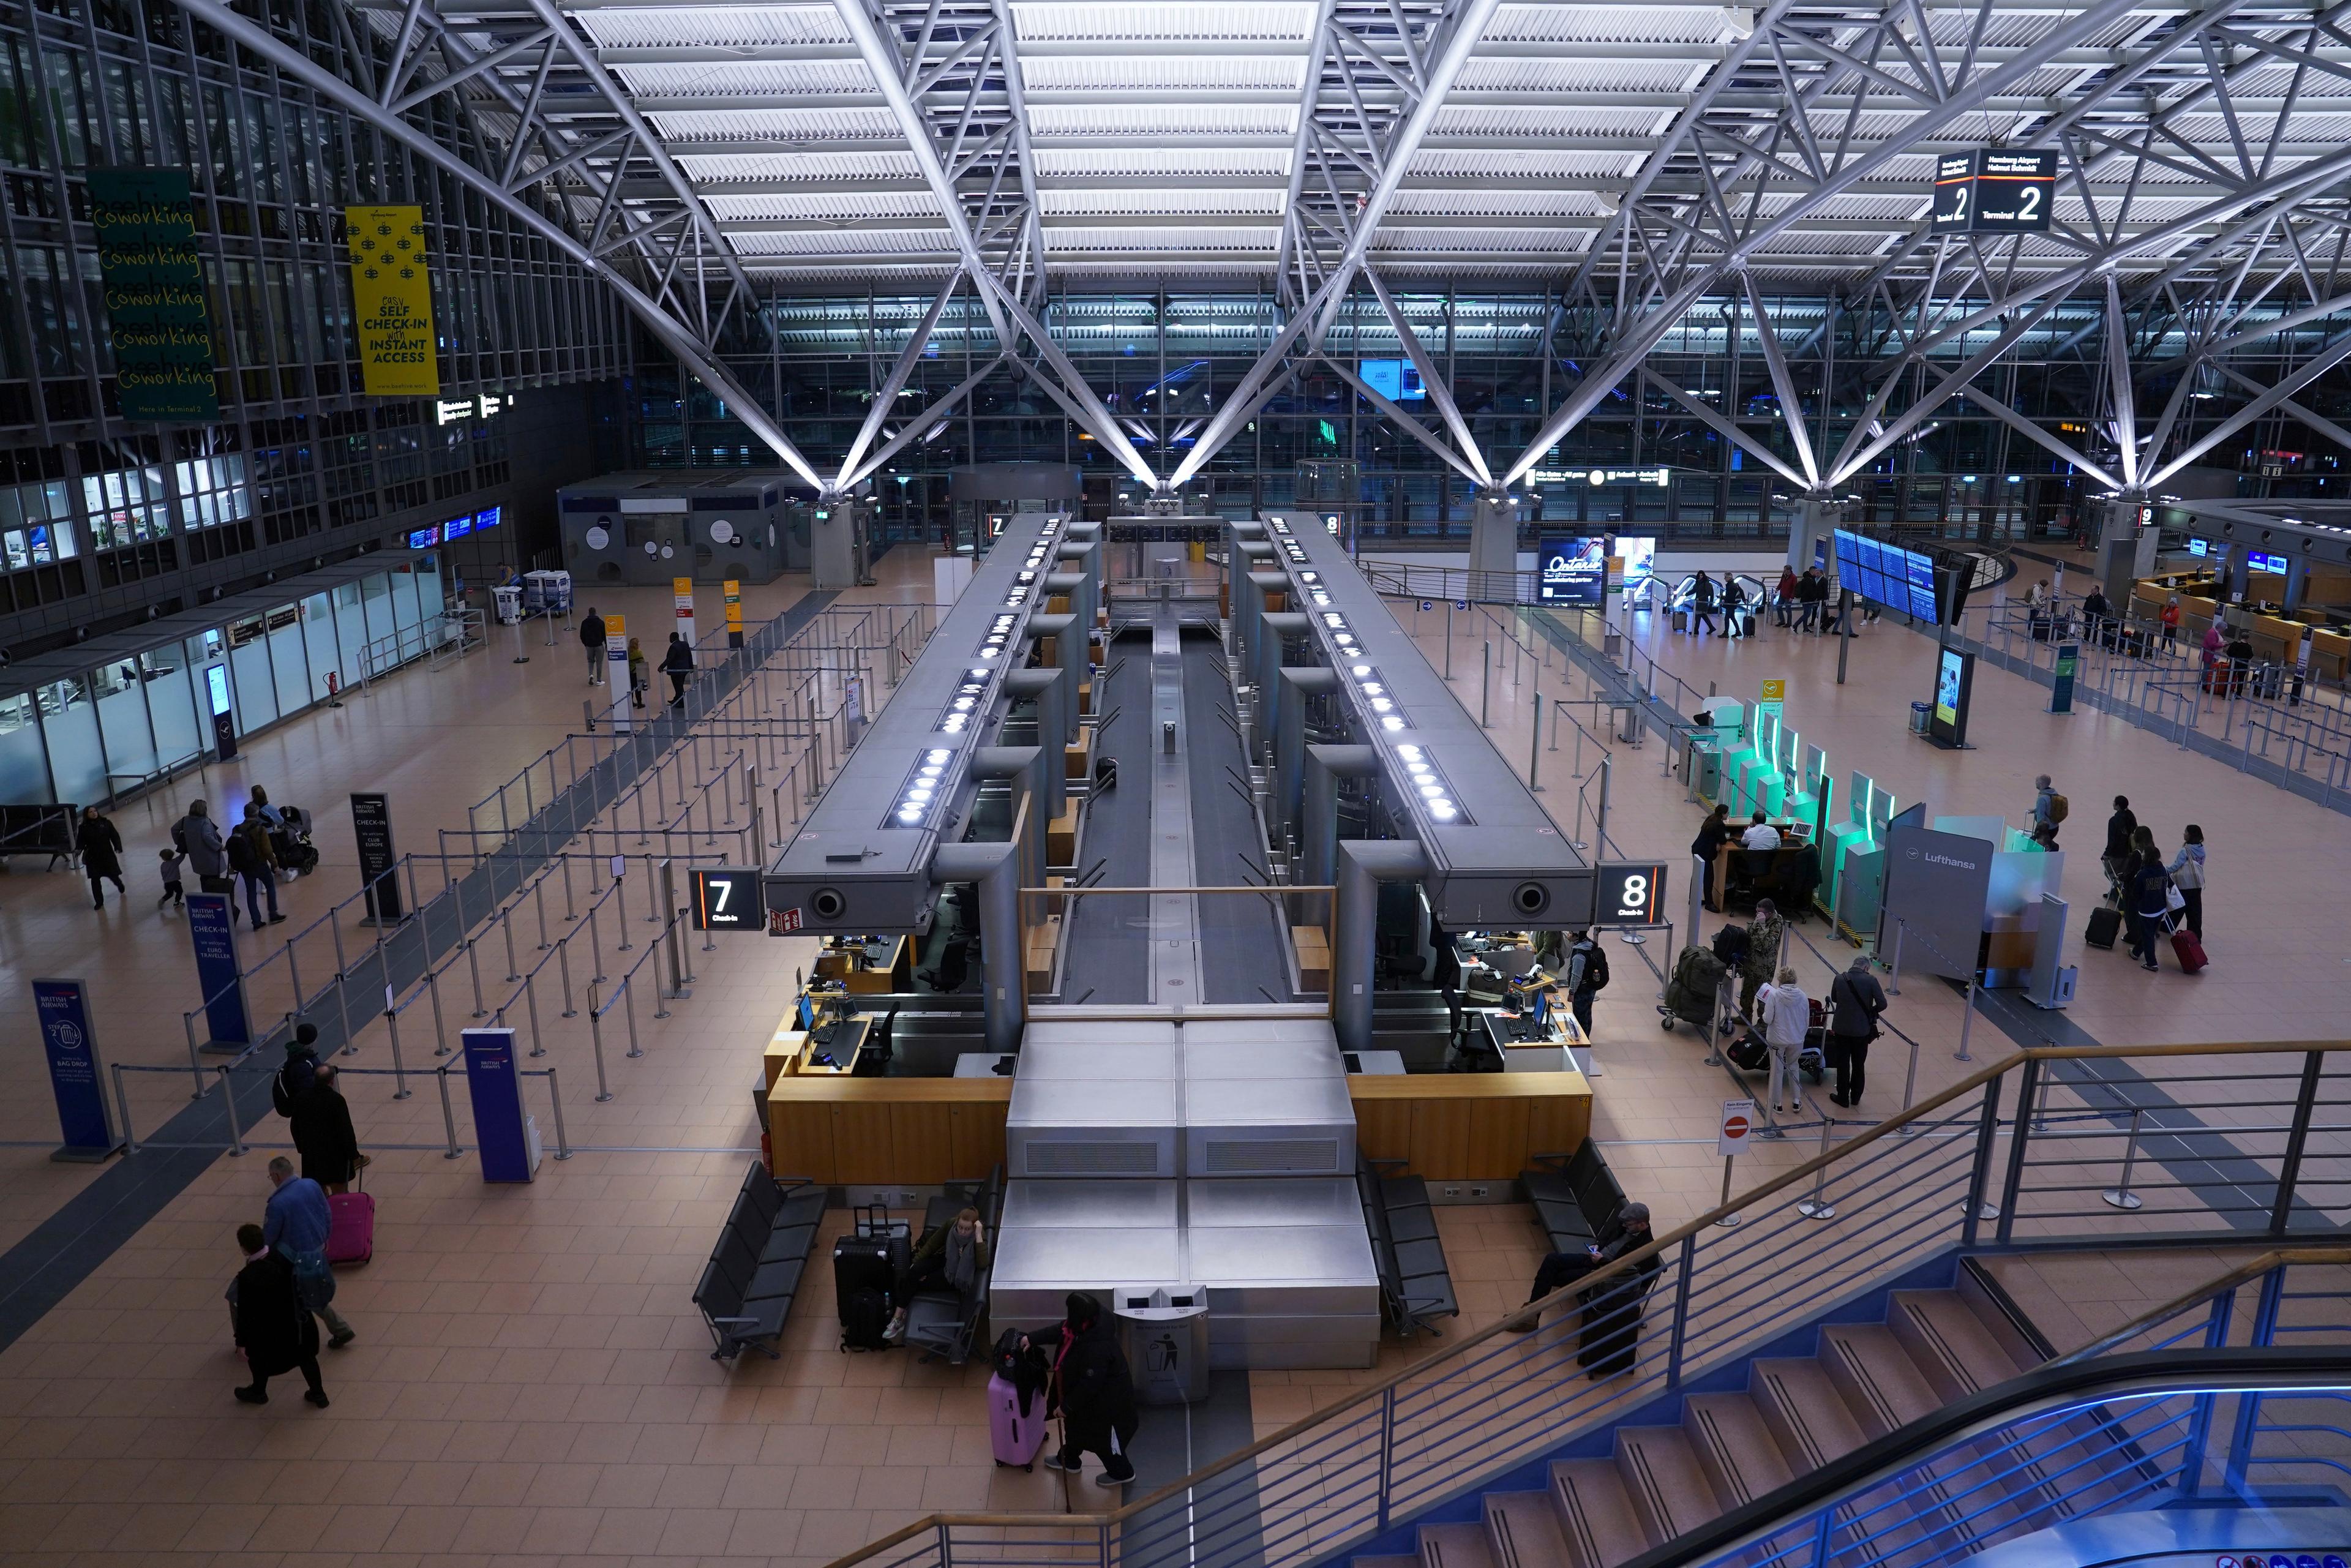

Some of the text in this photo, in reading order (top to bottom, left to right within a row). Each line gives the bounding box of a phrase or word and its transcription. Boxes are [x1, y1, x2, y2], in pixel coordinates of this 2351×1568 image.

[1989, 156, 2041, 165] Hamburg Airport
[1937, 187, 1968, 222] Terminal 2
[1982, 187, 2041, 220] Terminal 2
[94, 206, 195, 238] Coworking
[100, 246, 200, 277] Coworking
[106, 286, 206, 318] Coworking
[382, 296, 404, 309] easy
[380, 306, 410, 317] SELF
[364, 318, 427, 329] CHECK-IN
[387, 326, 405, 340] with
[112, 327, 211, 357] Coworking
[370, 340, 427, 350] INSTANT
[373, 352, 425, 362] ACCESS
[118, 367, 216, 396] Coworking
[1327, 516, 1337, 530] 8
[2142, 509, 2152, 521] 9
[992, 518, 1002, 531] 7
[1550, 556, 1602, 572] Ontario
[1925, 852, 1975, 870] Lufthansa
[710, 880, 732, 912] 7
[1622, 875, 1647, 907] 8
